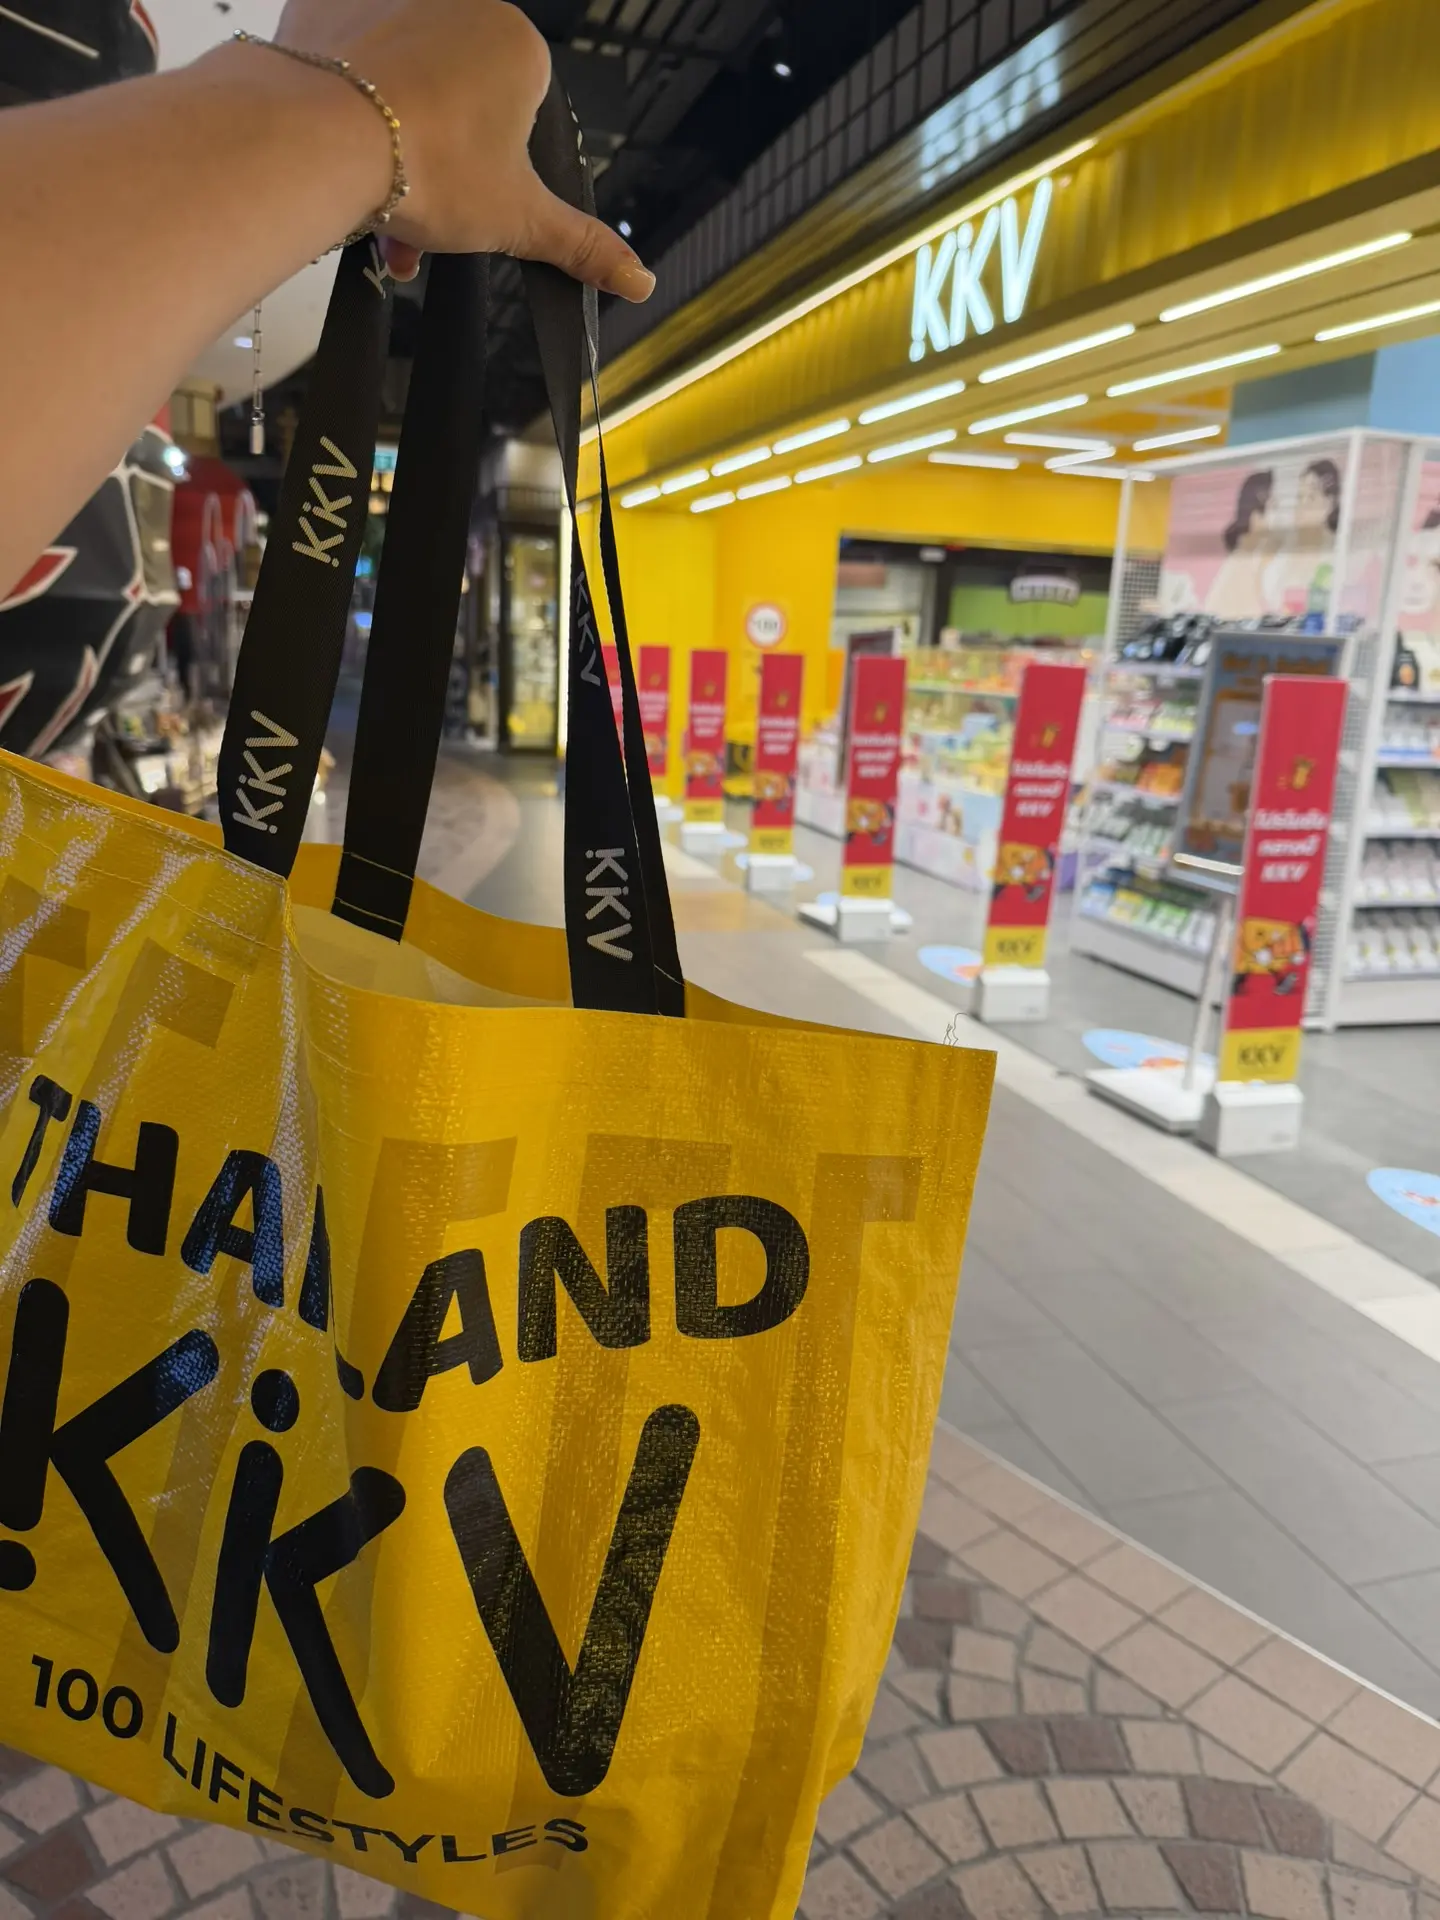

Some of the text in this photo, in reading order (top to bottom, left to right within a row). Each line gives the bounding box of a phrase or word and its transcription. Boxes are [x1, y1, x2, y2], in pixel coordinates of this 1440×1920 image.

[908, 175, 1054, 363] KKV
[291, 435, 358, 568] KKV
[232, 709, 299, 835] KKV
[585, 847, 634, 962] KKV
[11, 1074, 810, 1413] THAIAND
[0, 1278, 701, 1799] KKV
[31, 1654, 589, 1863] 100 LIFESTYLES
